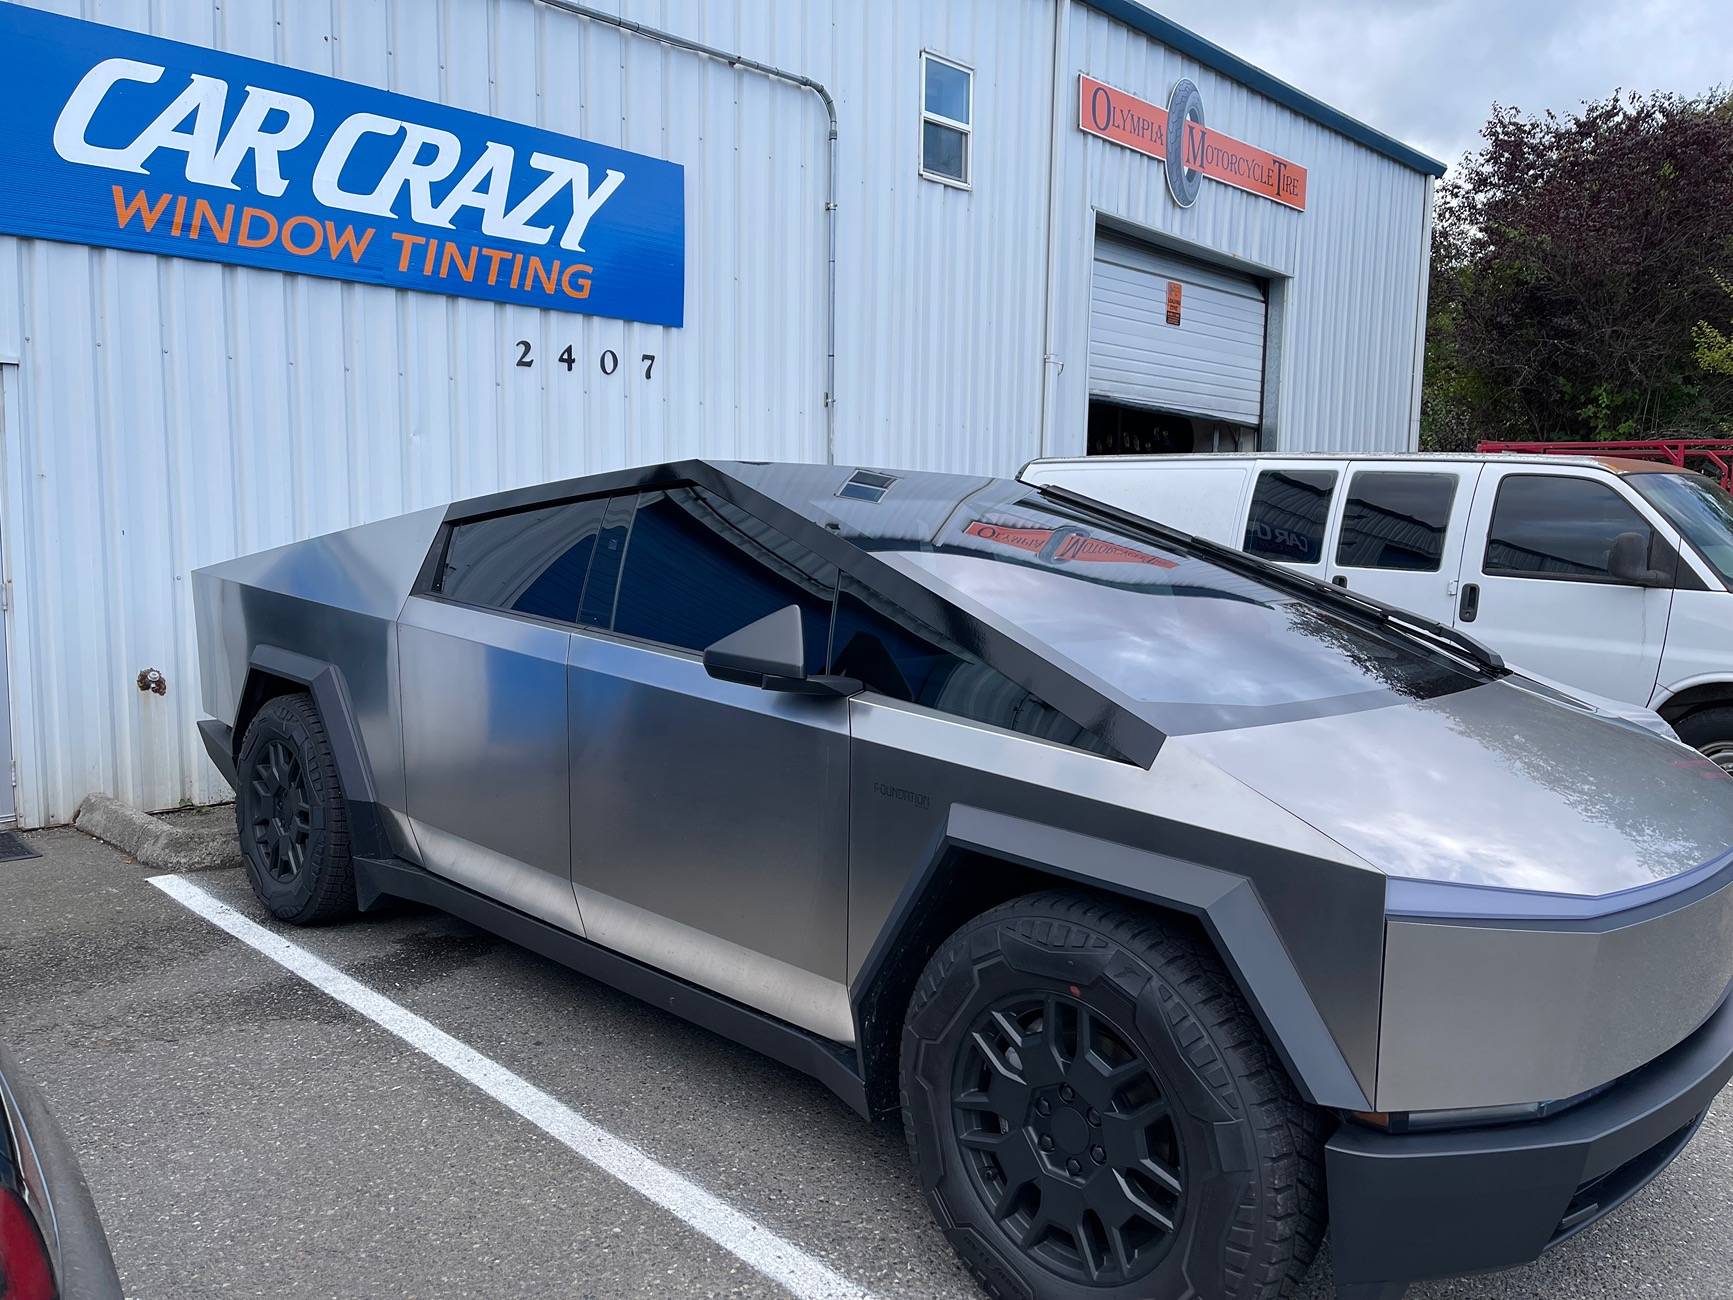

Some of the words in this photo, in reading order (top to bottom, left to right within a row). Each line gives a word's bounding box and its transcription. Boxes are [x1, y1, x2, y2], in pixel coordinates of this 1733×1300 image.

[52, 57, 315, 198] CAR
[311, 112, 626, 253] CRAZY
[1091, 86, 1164, 146] OLYMPIA
[1185, 124, 1274, 188] MOTORCYCLE
[111, 184, 376, 264] WINDOW
[390, 231, 594, 300] TINTING
